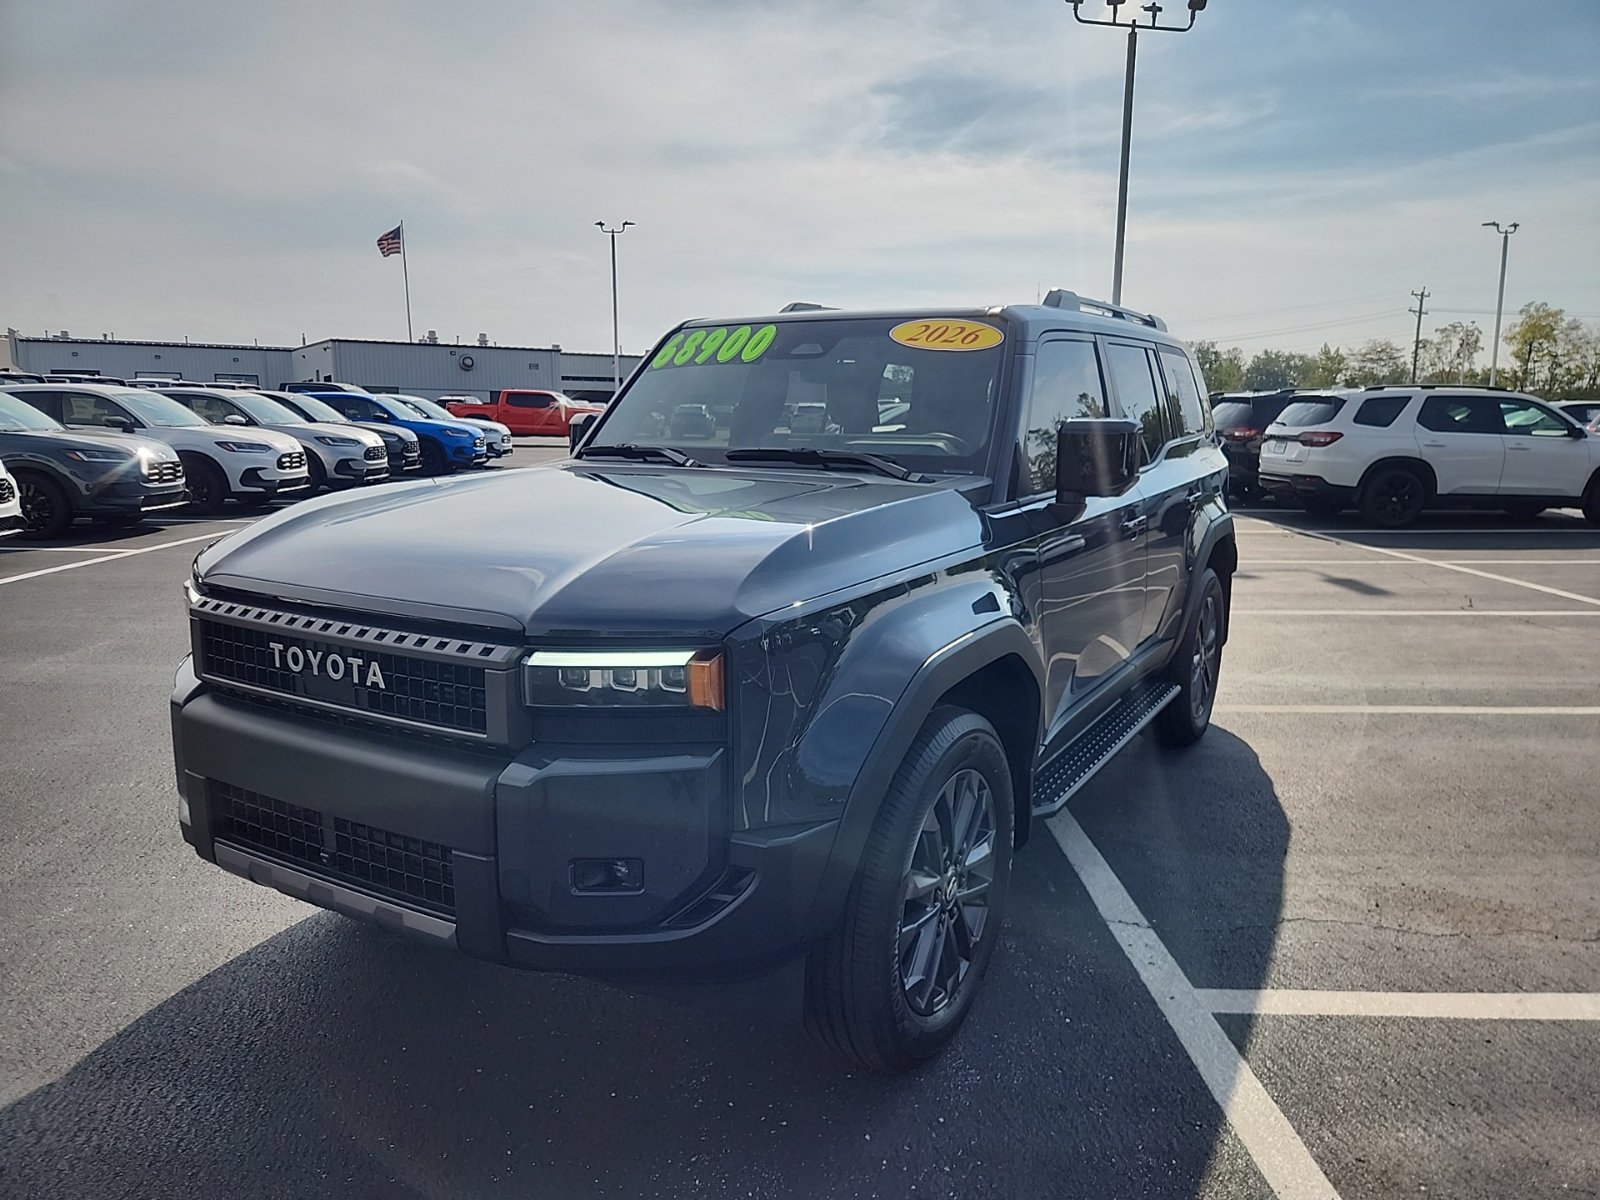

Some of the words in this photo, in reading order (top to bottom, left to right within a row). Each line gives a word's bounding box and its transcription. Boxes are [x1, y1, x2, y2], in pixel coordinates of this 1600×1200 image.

[651, 324, 778, 369] 68900
[904, 324, 985, 345] 2026
[269, 641, 386, 690] TOYOTA
